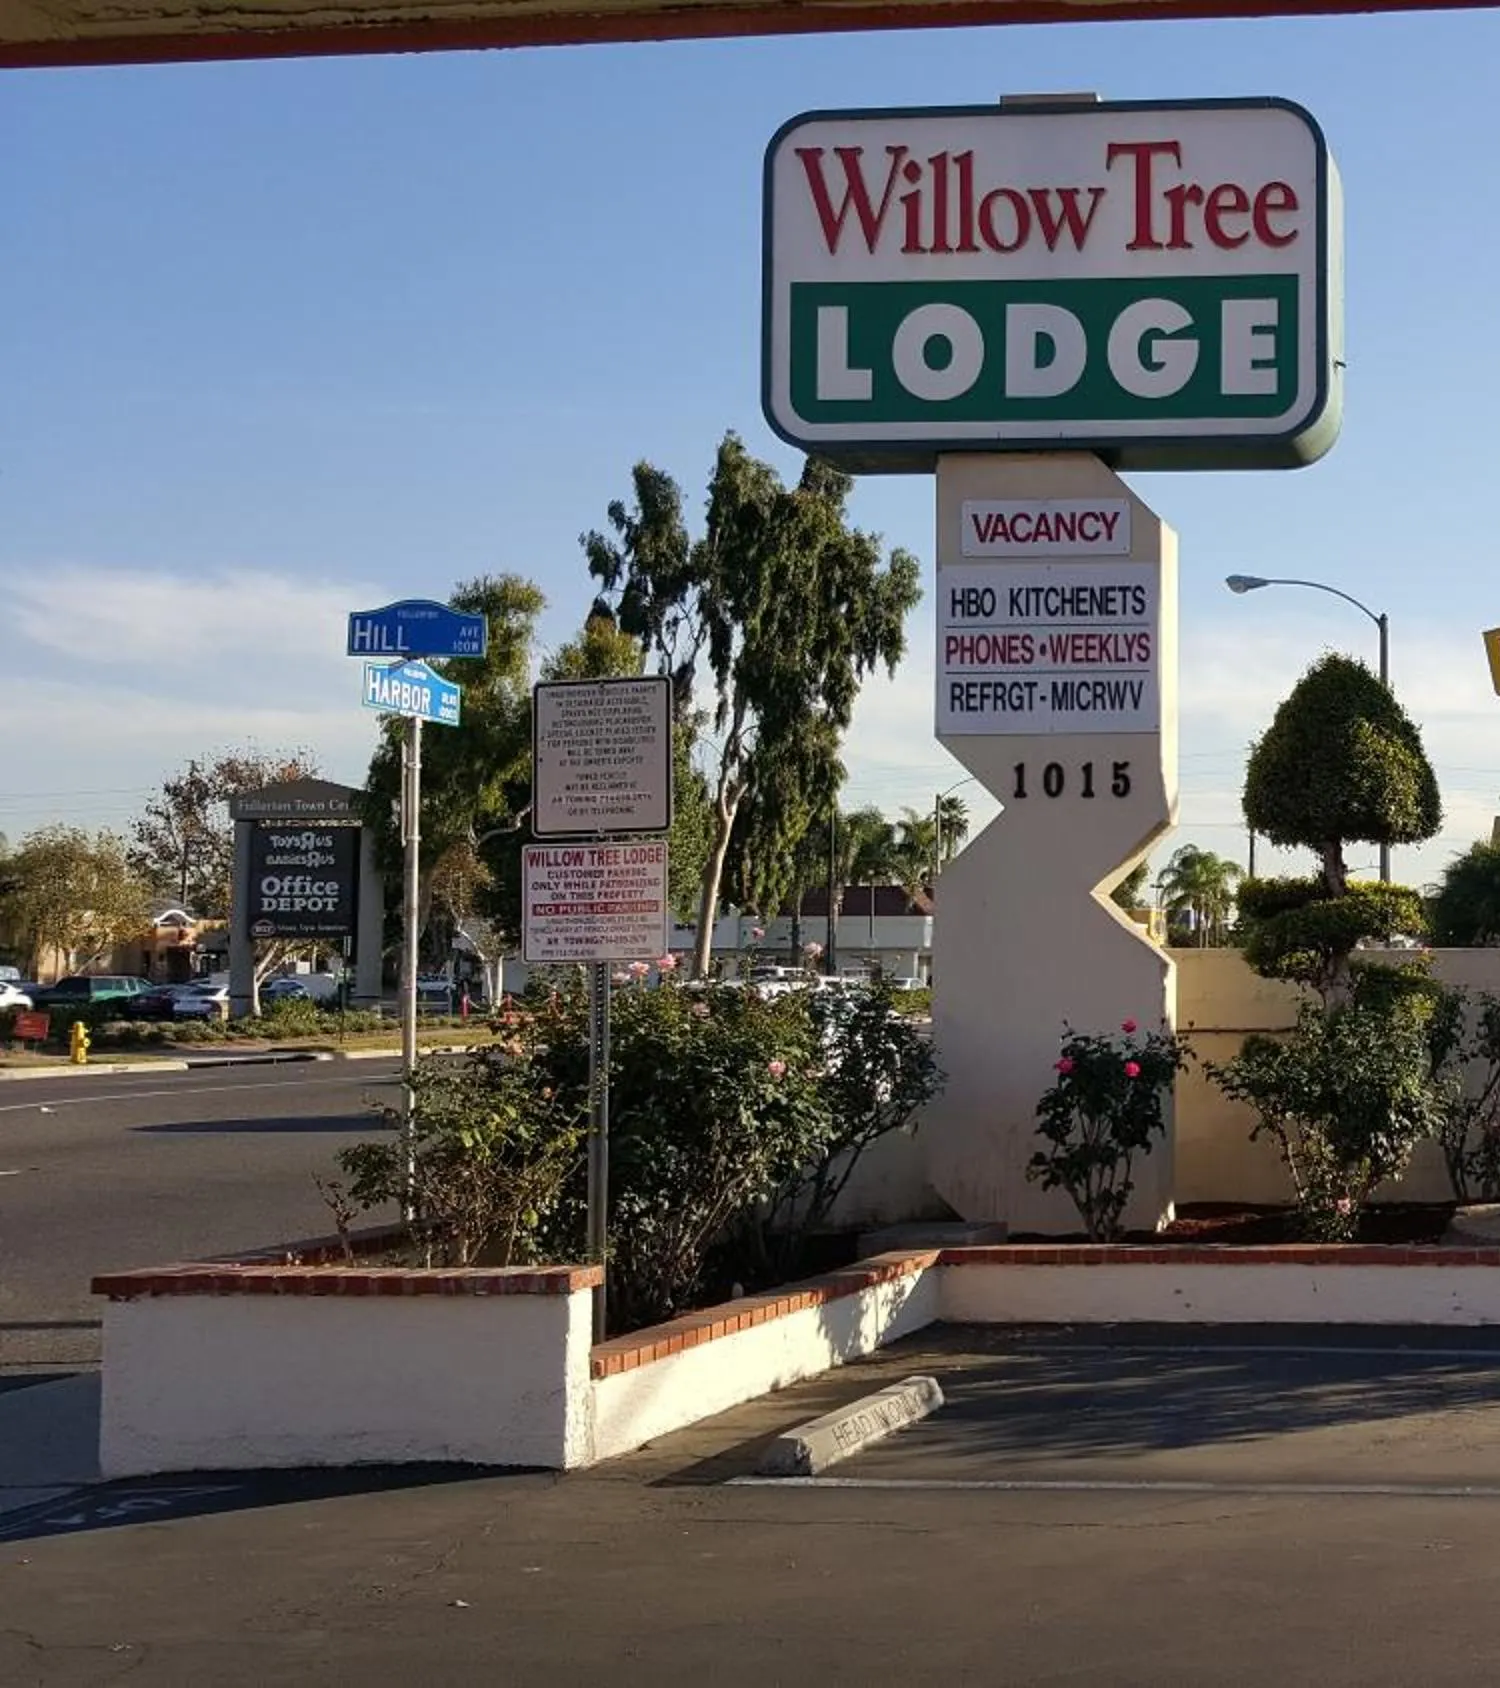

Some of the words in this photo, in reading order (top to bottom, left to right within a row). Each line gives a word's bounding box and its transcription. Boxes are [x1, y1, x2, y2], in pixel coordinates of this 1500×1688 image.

[795, 145, 1104, 255] Willow
[1105, 140, 1299, 251] Tree
[816, 298, 1279, 401] LODGE
[972, 511, 1120, 544] VACANCY
[951, 587, 997, 618] HBO
[1009, 585, 1146, 618] KITCHENETS
[354, 619, 411, 651] HILL
[368, 668, 431, 713] HARBOR
[1013, 761, 1131, 800] 1015
[528, 849, 585, 868] WILLOW
[587, 848, 621, 867] TREE
[623, 847, 663, 865] LODGE
[261, 875, 339, 896] Office
[531, 881, 561, 890] ONLY
[563, 880, 596, 890] WHILE
[547, 869, 604, 879] CUSTOMER
[260, 897, 340, 912] DEPOT
[551, 891, 567, 900] ON
